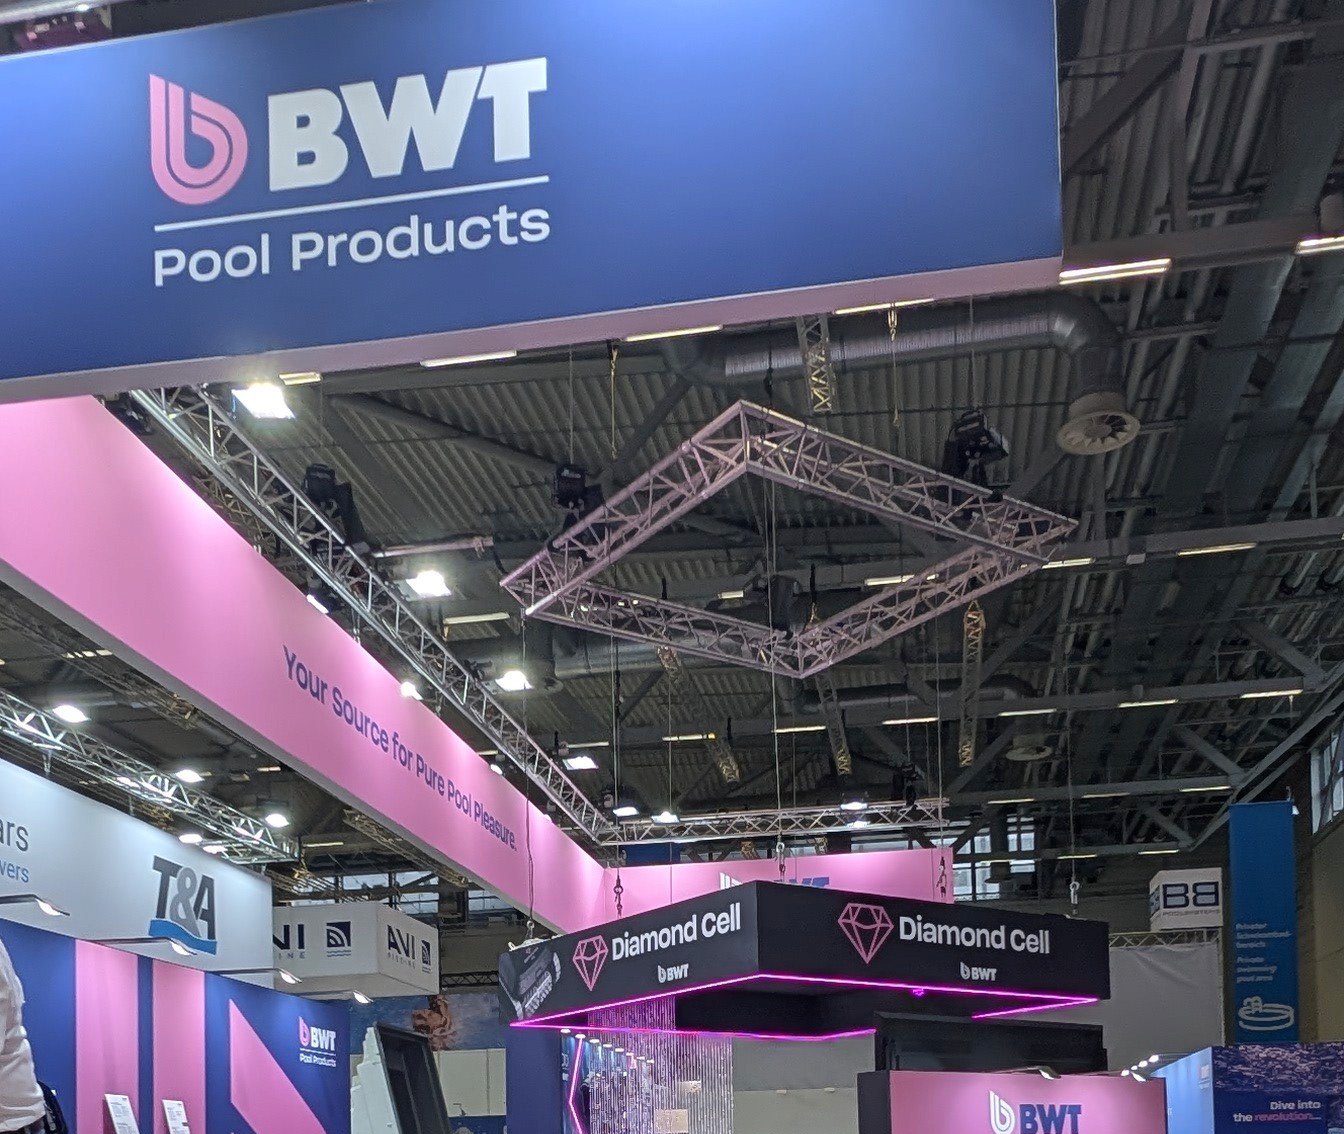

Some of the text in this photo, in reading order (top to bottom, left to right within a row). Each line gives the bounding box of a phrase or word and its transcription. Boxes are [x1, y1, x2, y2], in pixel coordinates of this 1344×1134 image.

[268, 57, 547, 191] BWT
[154, 204, 550, 286] Pool Products
[283, 645, 518, 851] Your Source for Pure Pool Pleasure.
[152, 855, 217, 940] T&A
[387, 924, 416, 960] AVI
[612, 901, 741, 961] Diamond Cell
[898, 915, 1051, 955] Diamond Cell
[667, 963, 689, 982] BWT
[971, 966, 997, 982] BWT
[310, 1026, 336, 1051] BWT
[1233, 1112, 1253, 1122] the
[1270, 1100, 1321, 1110] Dive into
